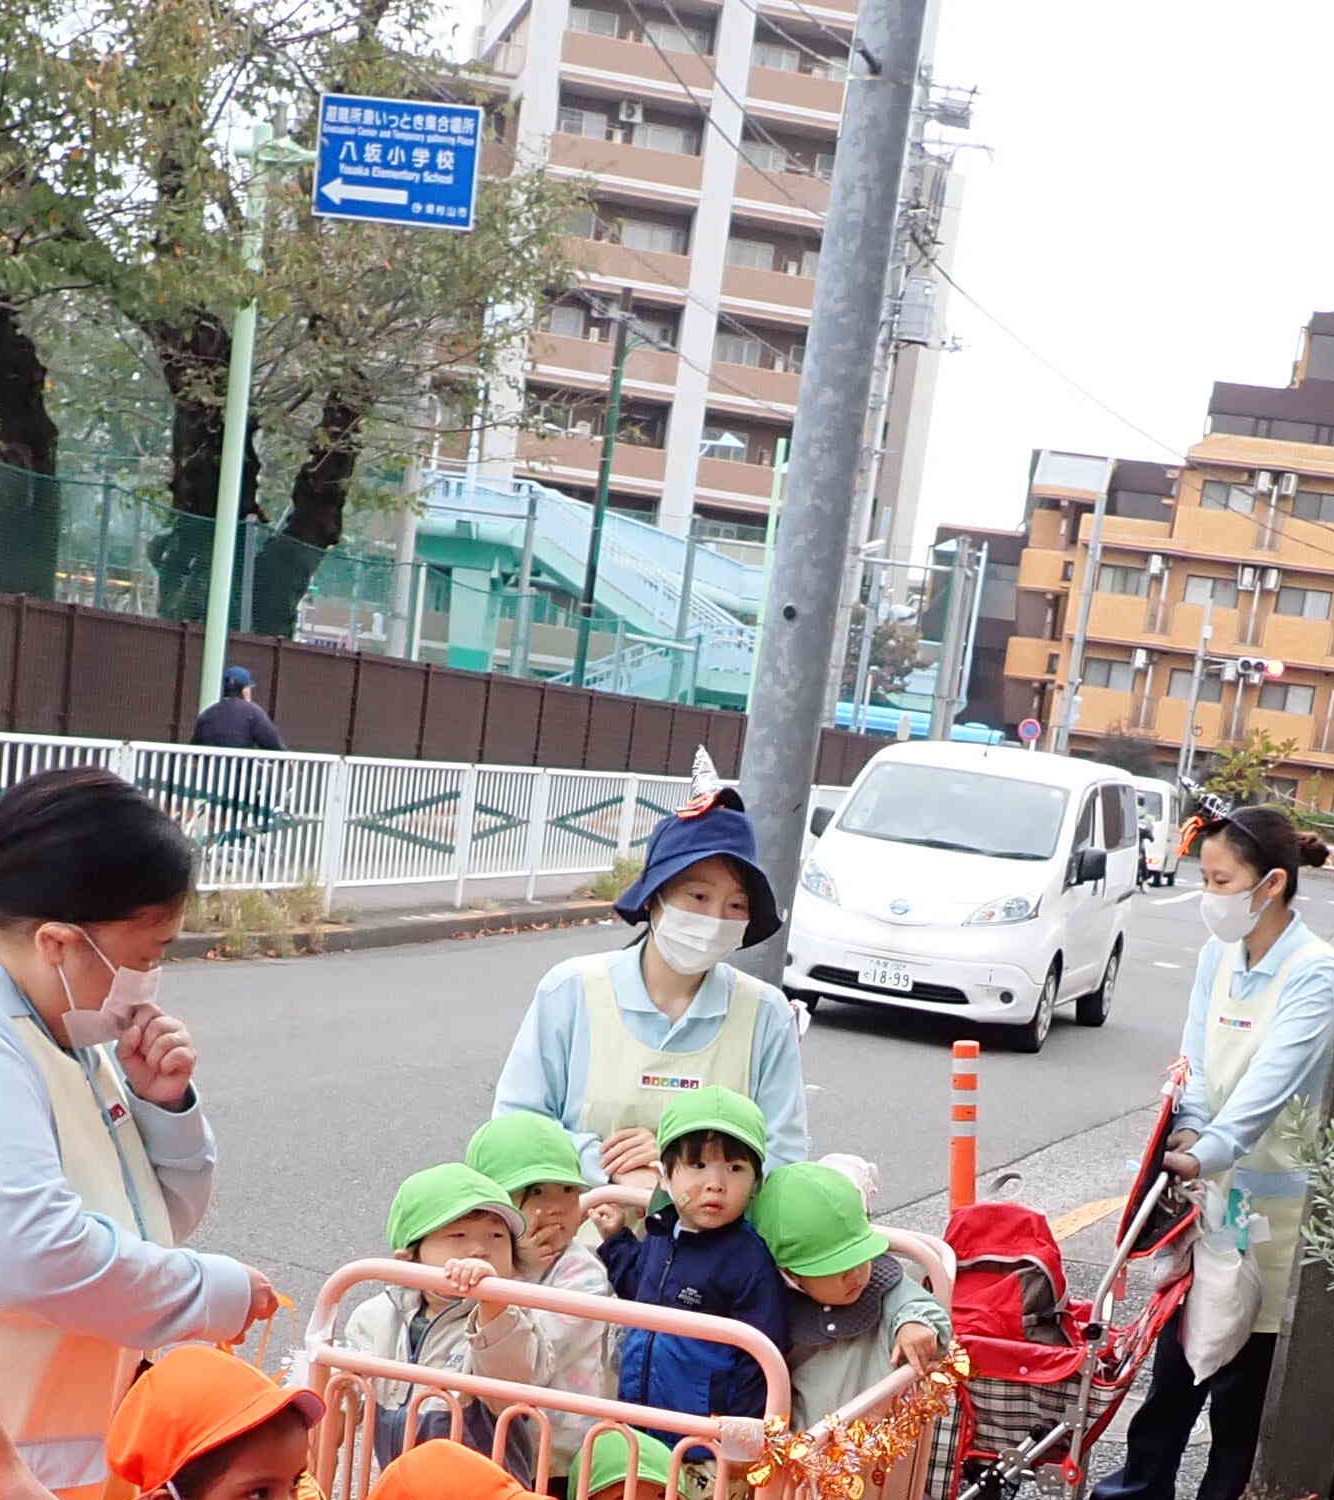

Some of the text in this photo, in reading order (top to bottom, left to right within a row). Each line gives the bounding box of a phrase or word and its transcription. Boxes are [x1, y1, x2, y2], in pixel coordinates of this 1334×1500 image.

[339, 141, 455, 170] 八坂小学校
